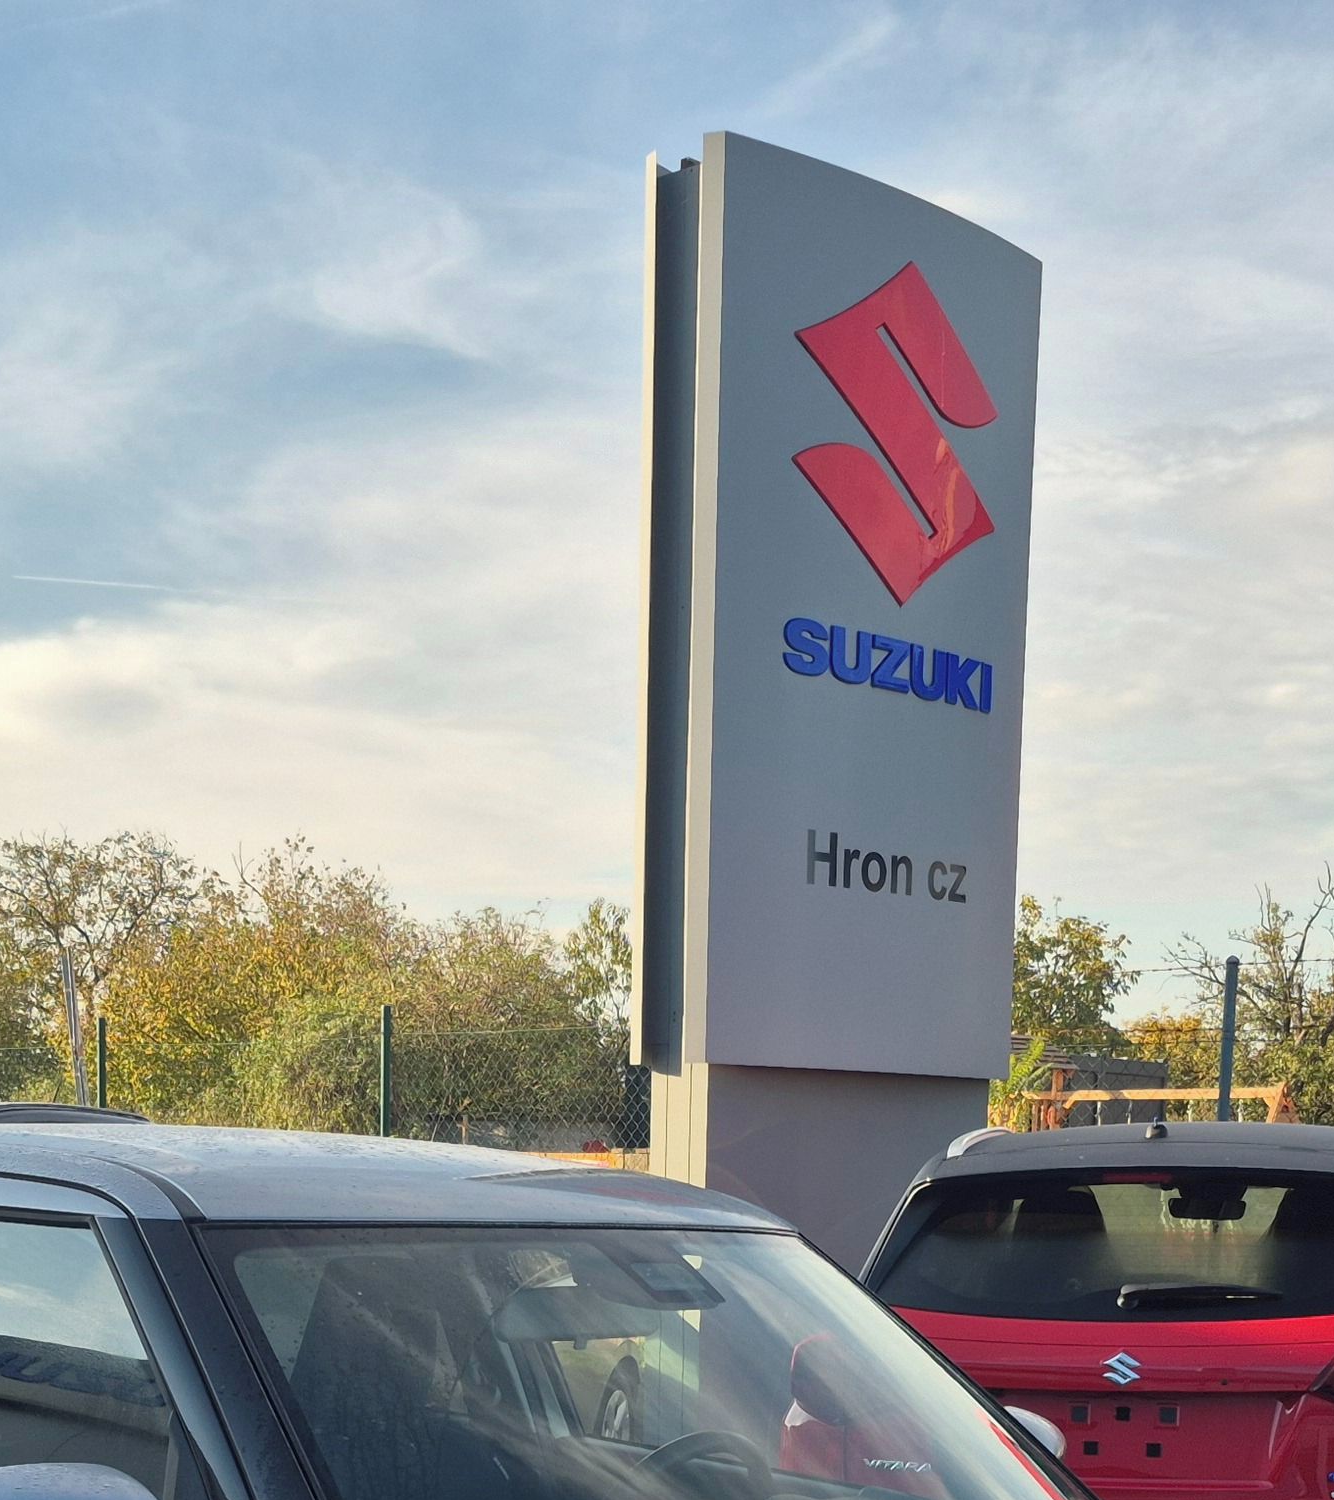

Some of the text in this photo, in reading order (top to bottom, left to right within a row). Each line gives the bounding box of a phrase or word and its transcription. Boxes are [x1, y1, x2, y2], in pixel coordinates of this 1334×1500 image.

[782, 617, 993, 714] SUZUKI
[806, 828, 967, 903] Hron cz
[863, 1458, 932, 1473] VITARA
